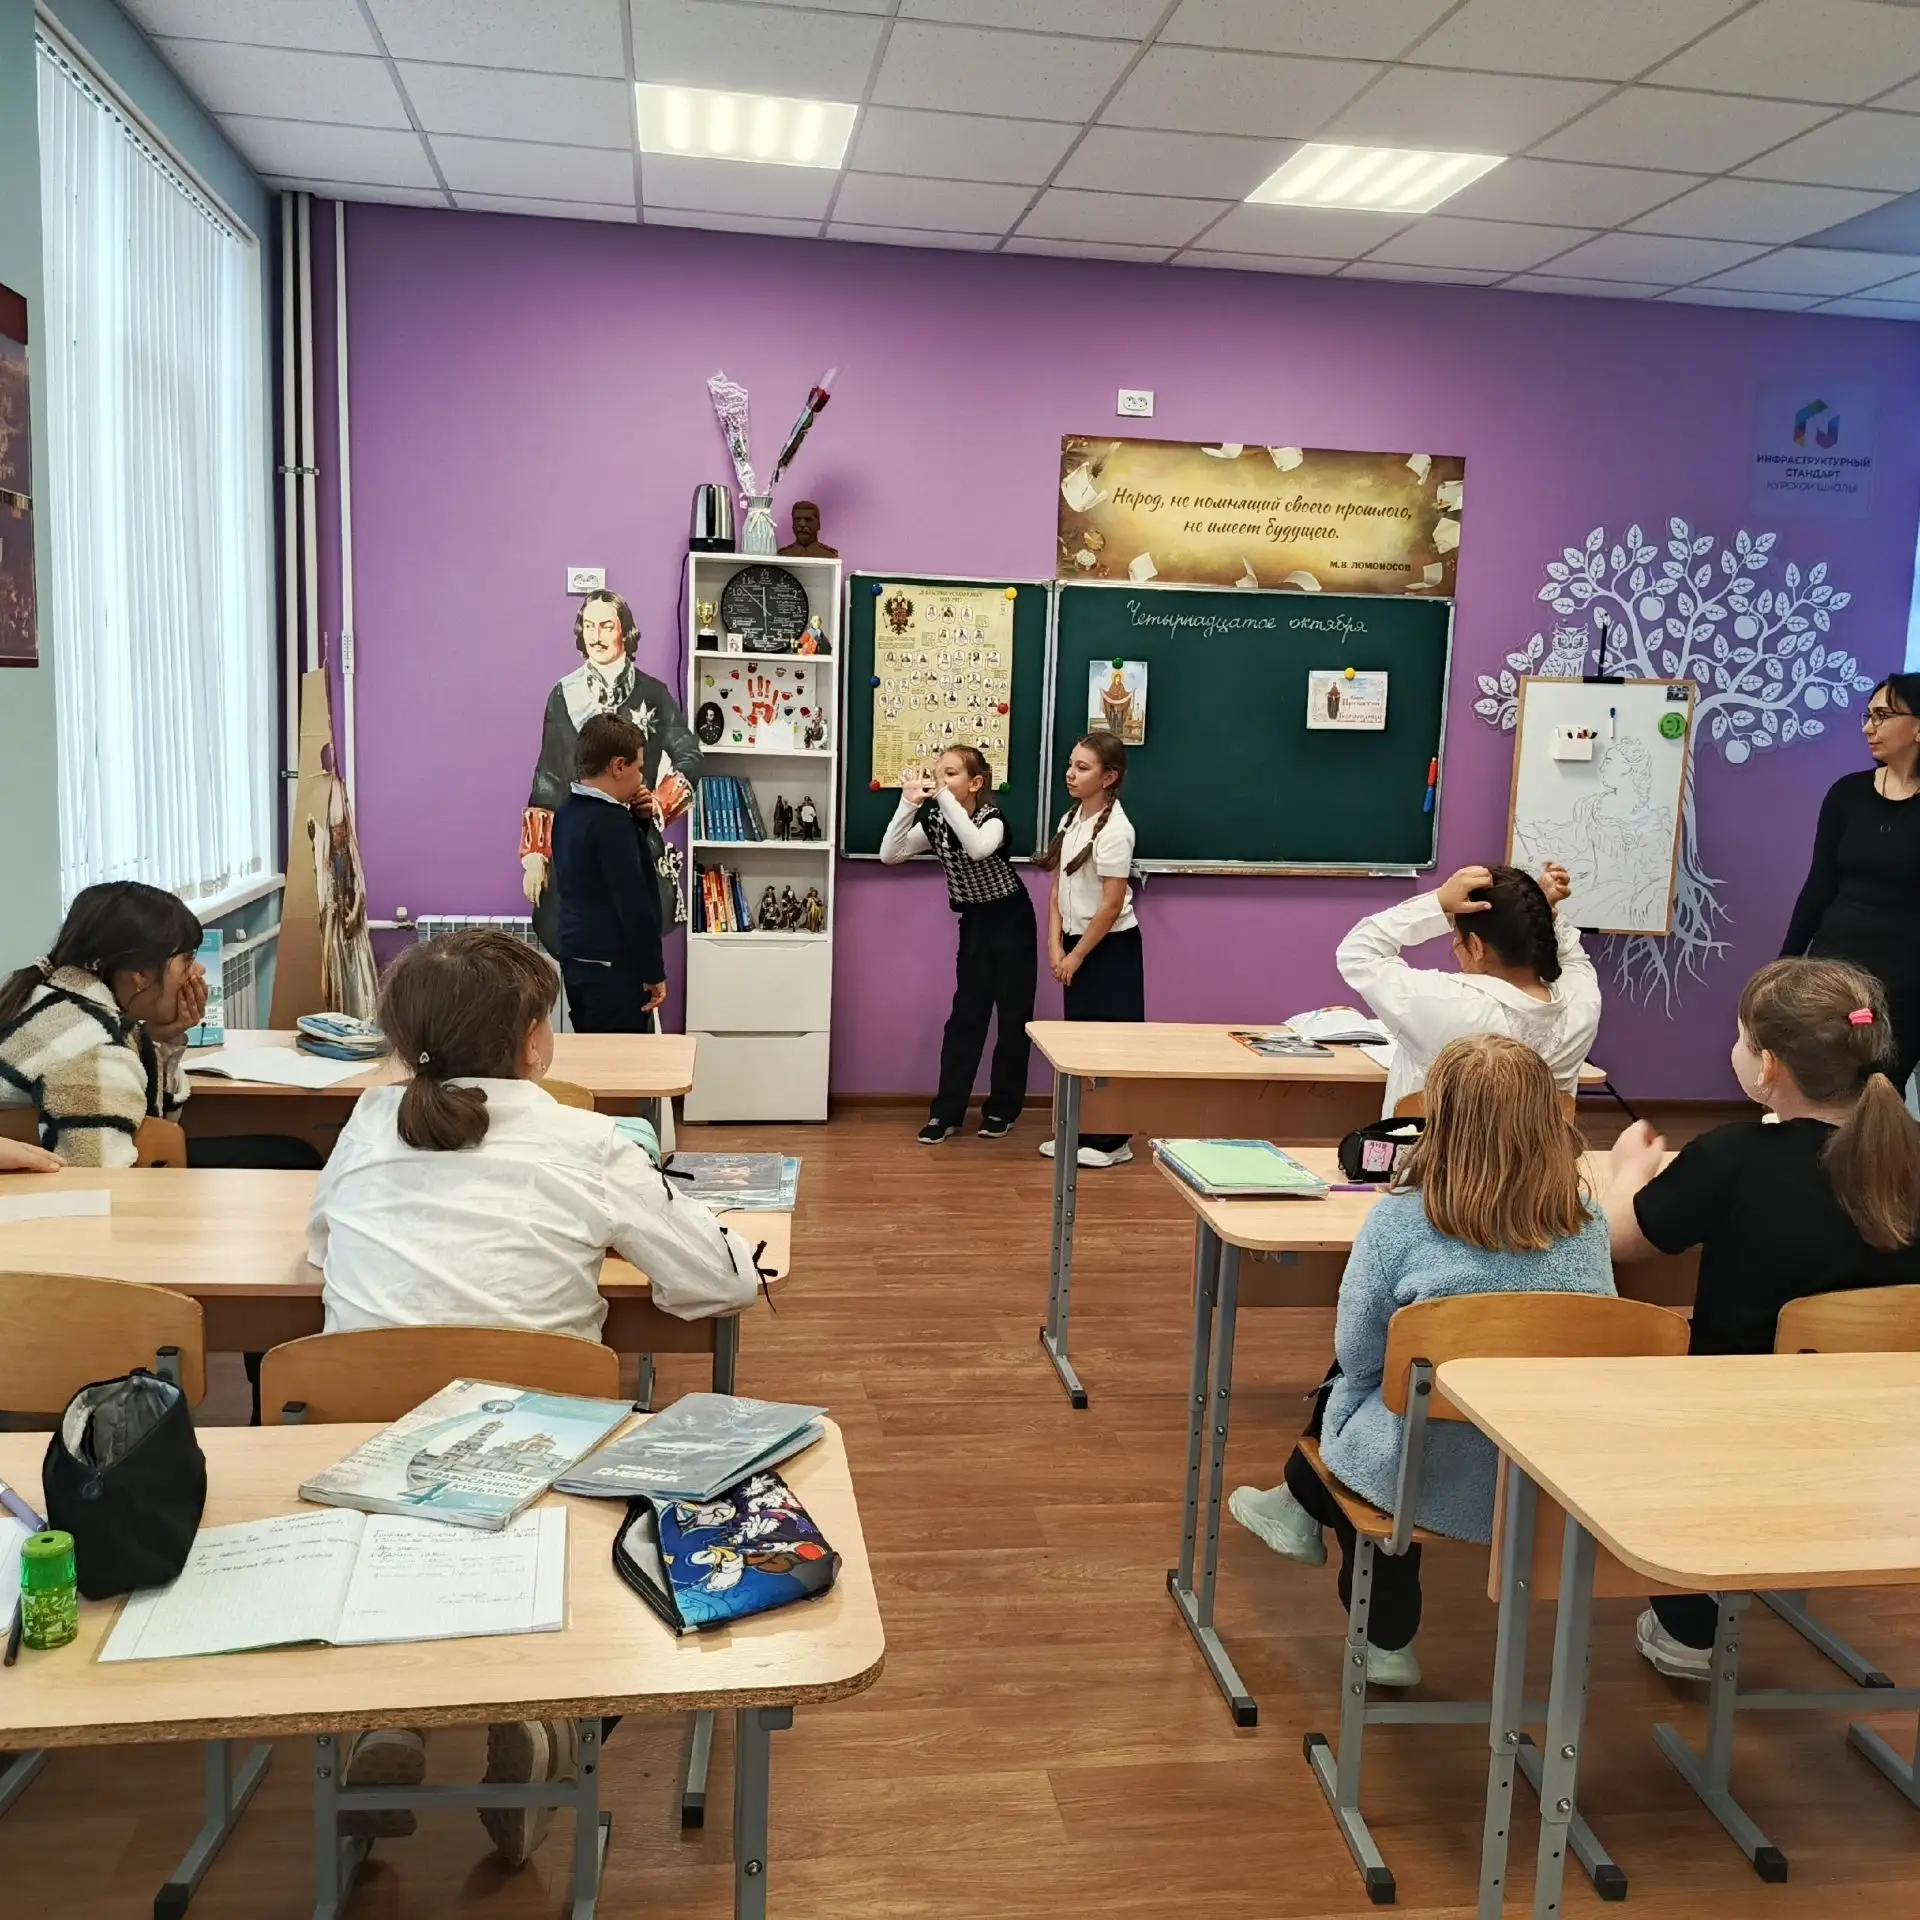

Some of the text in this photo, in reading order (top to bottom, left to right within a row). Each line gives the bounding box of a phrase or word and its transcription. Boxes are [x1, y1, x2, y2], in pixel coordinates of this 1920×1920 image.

[1756, 454, 1871, 468] ИНФРАСТРУКТУРНЫЙ
[1785, 468, 1841, 479] СТАНДАРТ
[1112, 487, 1413, 521] Народ, не помнящий своего прошлого,
[1183, 517, 1340, 543] не имеет будущего.
[1350, 561, 1412, 572] ЛОМОНОСОВ
[1127, 600, 1369, 644] Четырнадцатое октября
[424, 1470, 530, 1491] ПРАВОСЛАВНОЙ
[482, 1471, 540, 1485] ОСНОВЫ
[452, 1483, 522, 1498] КУЛЬТУРЫ
